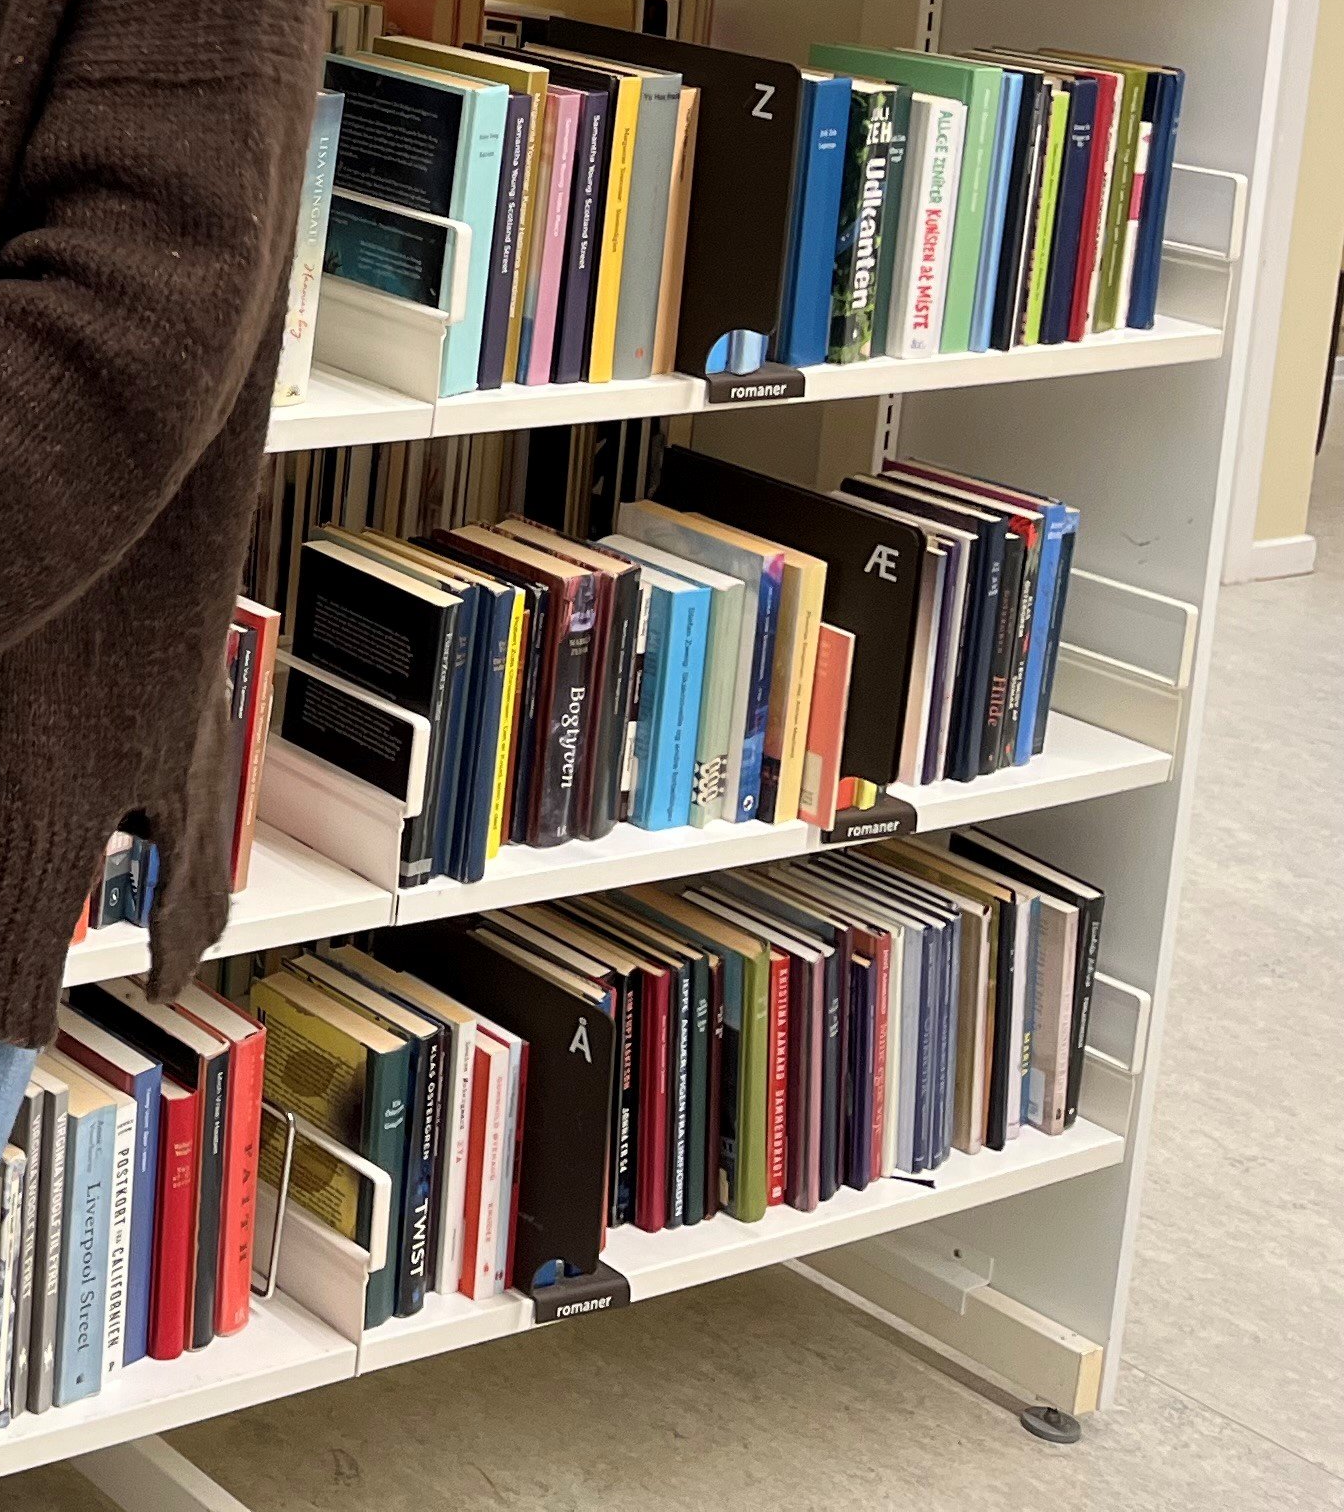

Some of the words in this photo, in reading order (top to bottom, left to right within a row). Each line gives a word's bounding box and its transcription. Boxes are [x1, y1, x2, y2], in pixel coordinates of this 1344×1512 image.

[752, 83, 775, 120] Z
[852, 157, 885, 309] Udkanten
[731, 383, 786, 399] romaner
[864, 544, 900, 582] Æ
[561, 687, 585, 789] Bogtyven
[847, 820, 900, 837] romaner
[114, 1147, 130, 1228] POSTKORT
[80, 1182, 102, 1287] Liverpool
[410, 1198, 429, 1277] TWIST
[76, 1290, 96, 1354] Street
[557, 1295, 612, 1317] romaner
